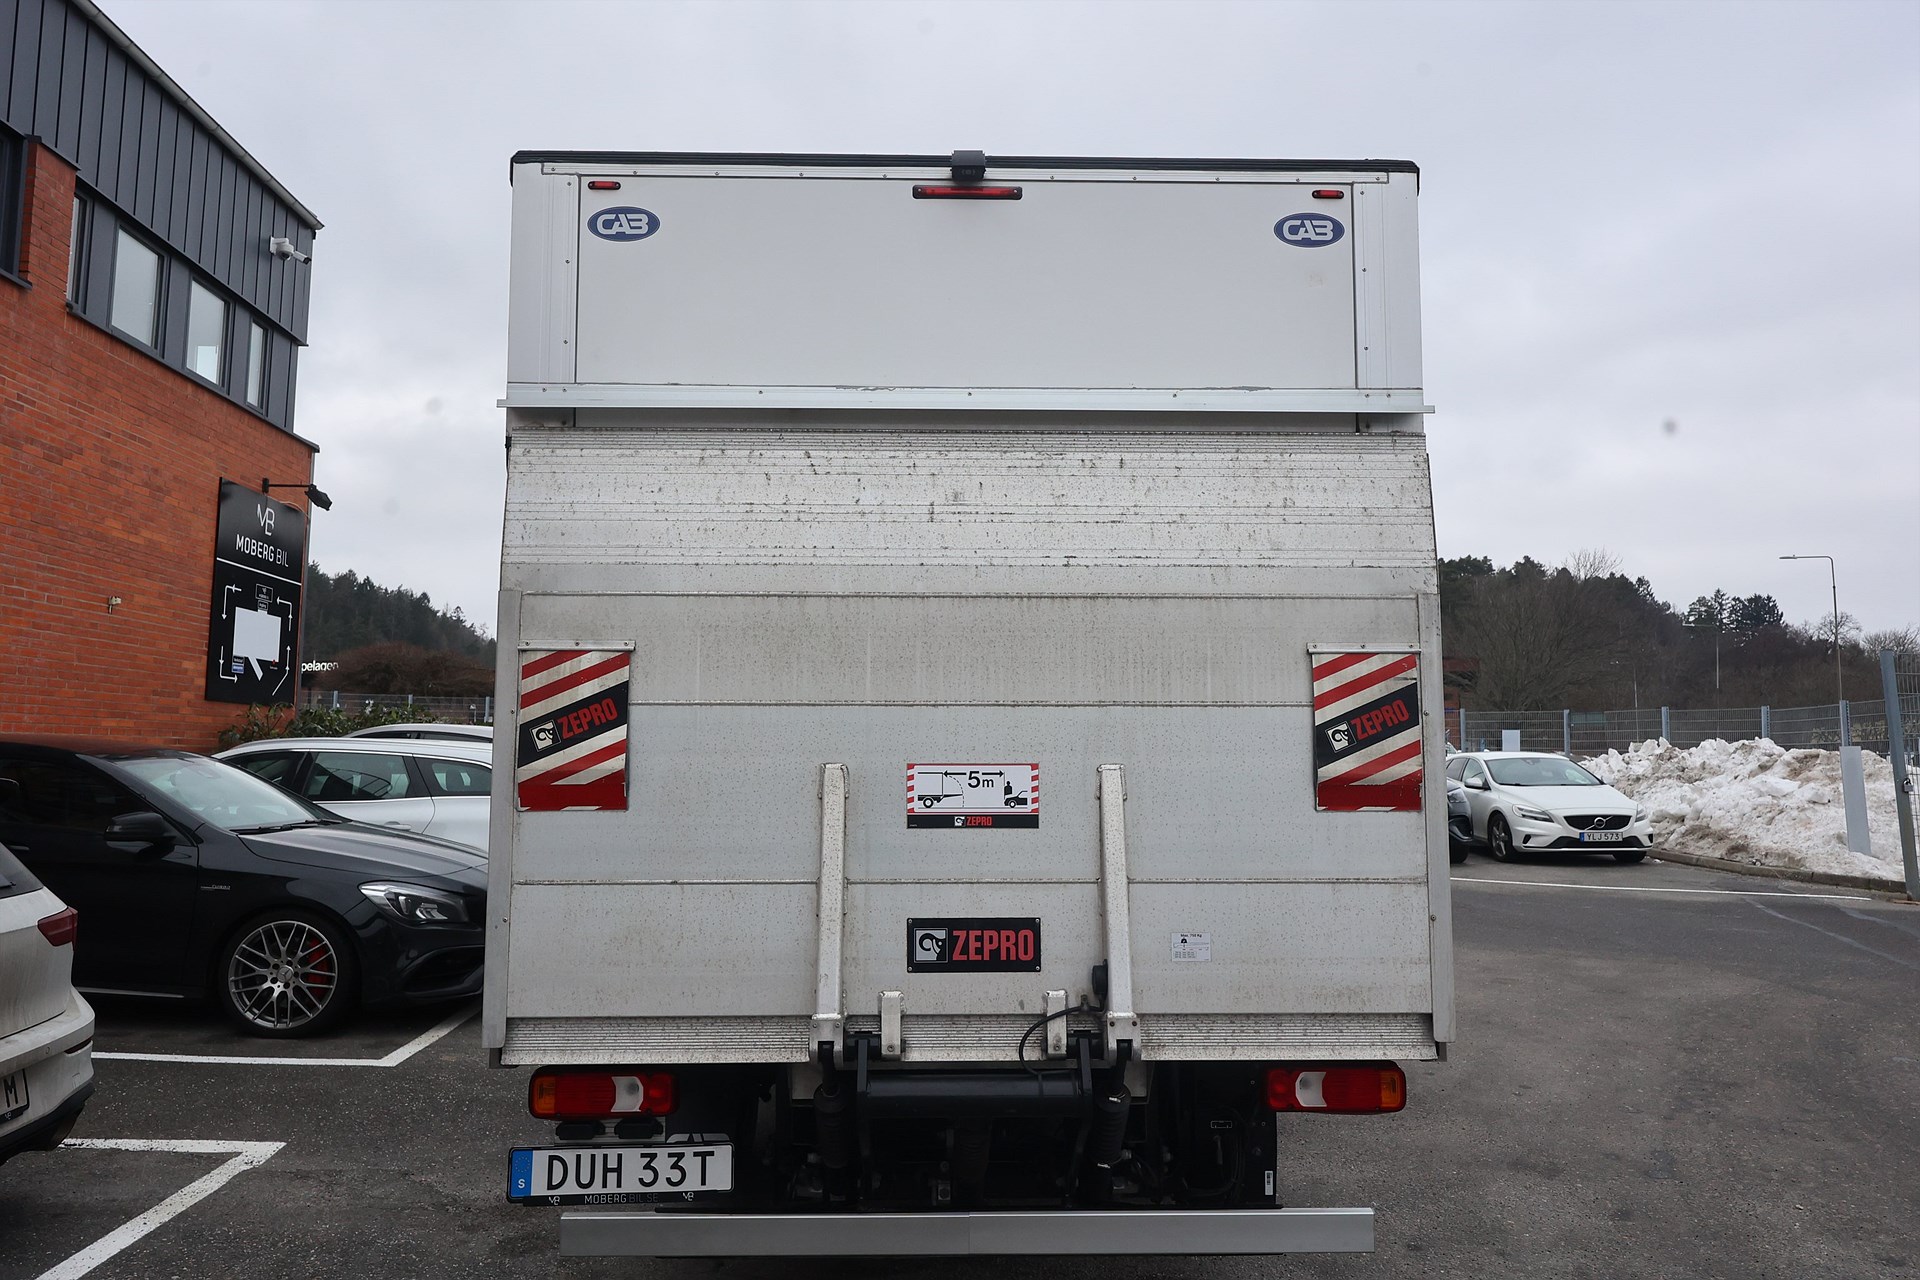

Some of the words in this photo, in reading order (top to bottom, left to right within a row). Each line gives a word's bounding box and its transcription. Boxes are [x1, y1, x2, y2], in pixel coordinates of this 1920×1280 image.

[596, 213, 649, 235] CAB
[1282, 219, 1334, 241] CAB
[235, 533, 275, 562] MOBERG
[275, 548, 289, 568] BIL
[557, 697, 618, 740] ZEPRO
[1351, 699, 1410, 741] ZEPRO
[966, 816, 993, 826] ZEPRO
[952, 929, 1034, 961] ZEPRO
[3, 1075, 19, 1108] M
[517, 1178, 526, 1189] S
[546, 1152, 623, 1191] DUH
[638, 1150, 715, 1188] 33T
[584, 1193, 627, 1205] MOBERG
